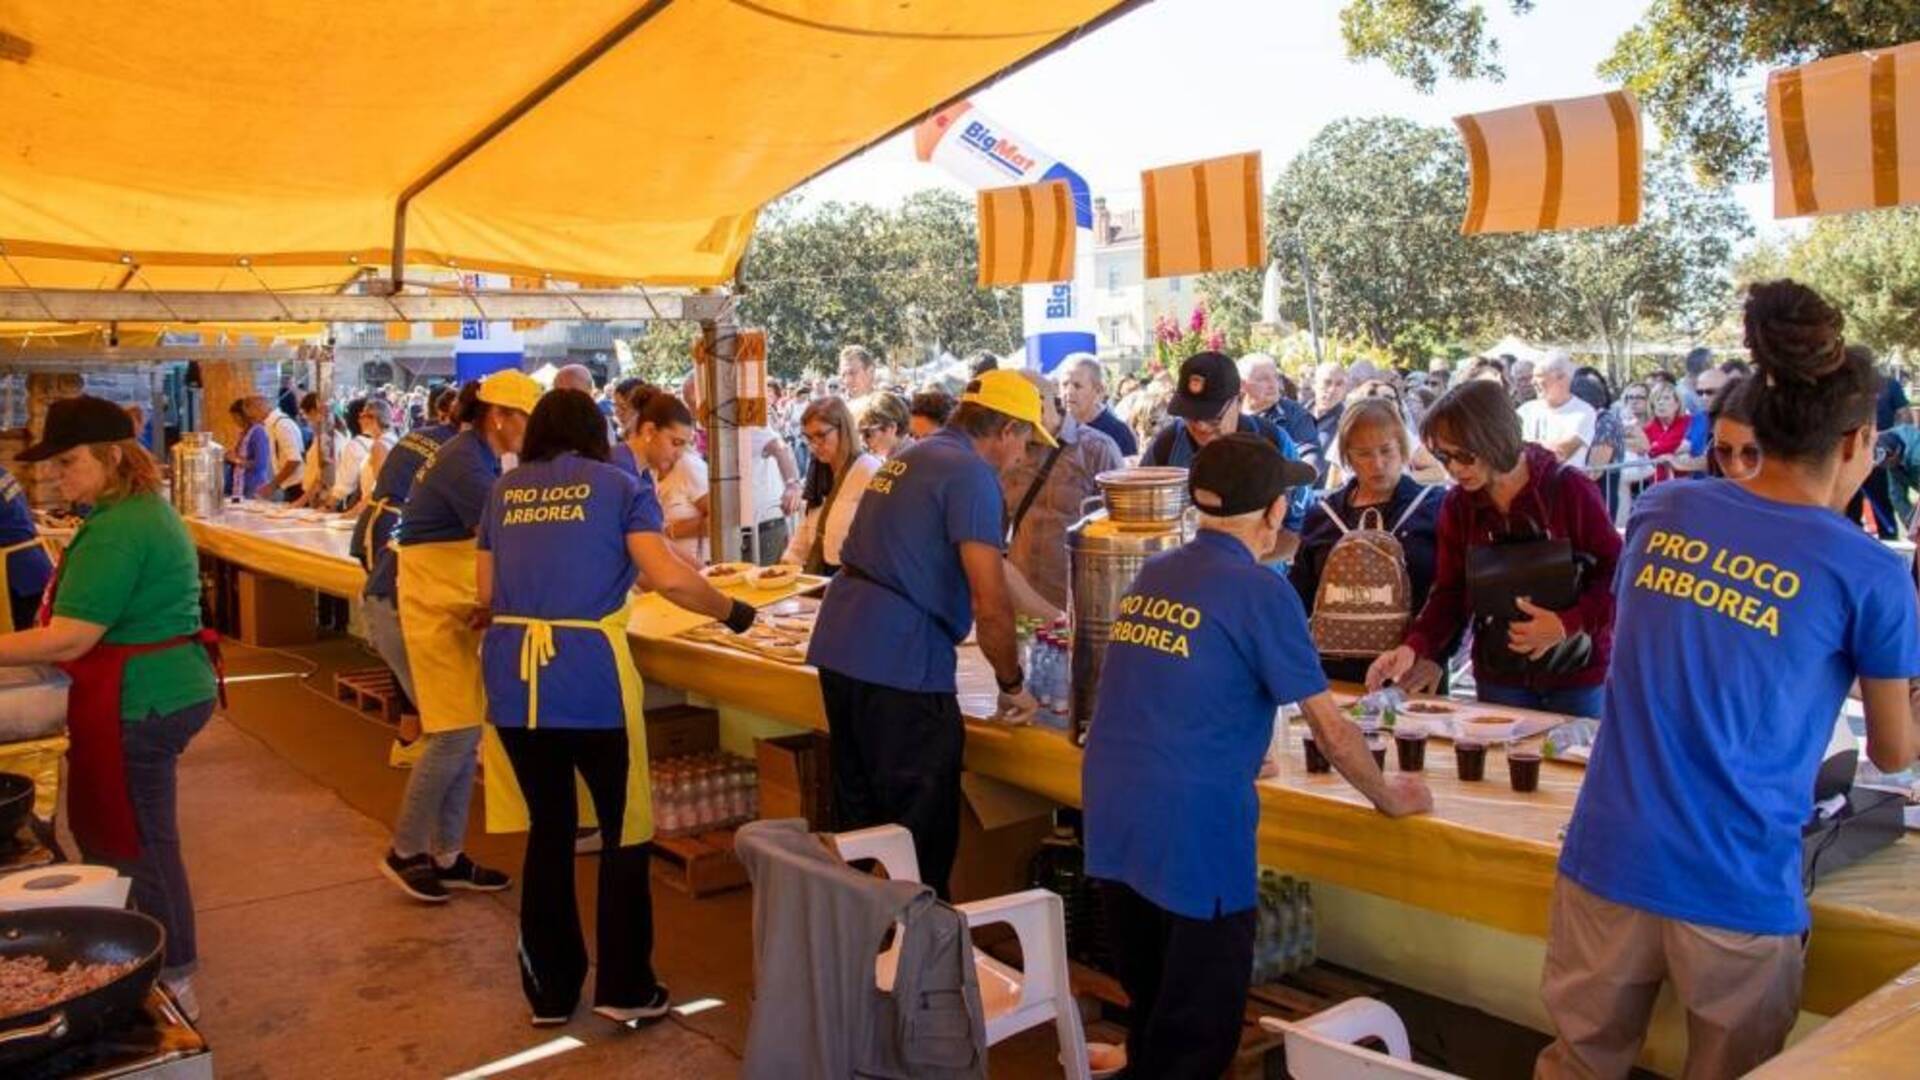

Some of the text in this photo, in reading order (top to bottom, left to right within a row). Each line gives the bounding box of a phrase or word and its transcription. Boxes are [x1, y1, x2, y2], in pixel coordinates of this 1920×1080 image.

[965, 121, 1035, 171] BigMat
[503, 484, 590, 506] PRO LOCO
[503, 504, 585, 527] ARBOREA
[1646, 531, 1800, 599] PRO LOCO
[1143, 597, 1201, 630] LOCO
[1634, 564, 1780, 636] ARBOREA
